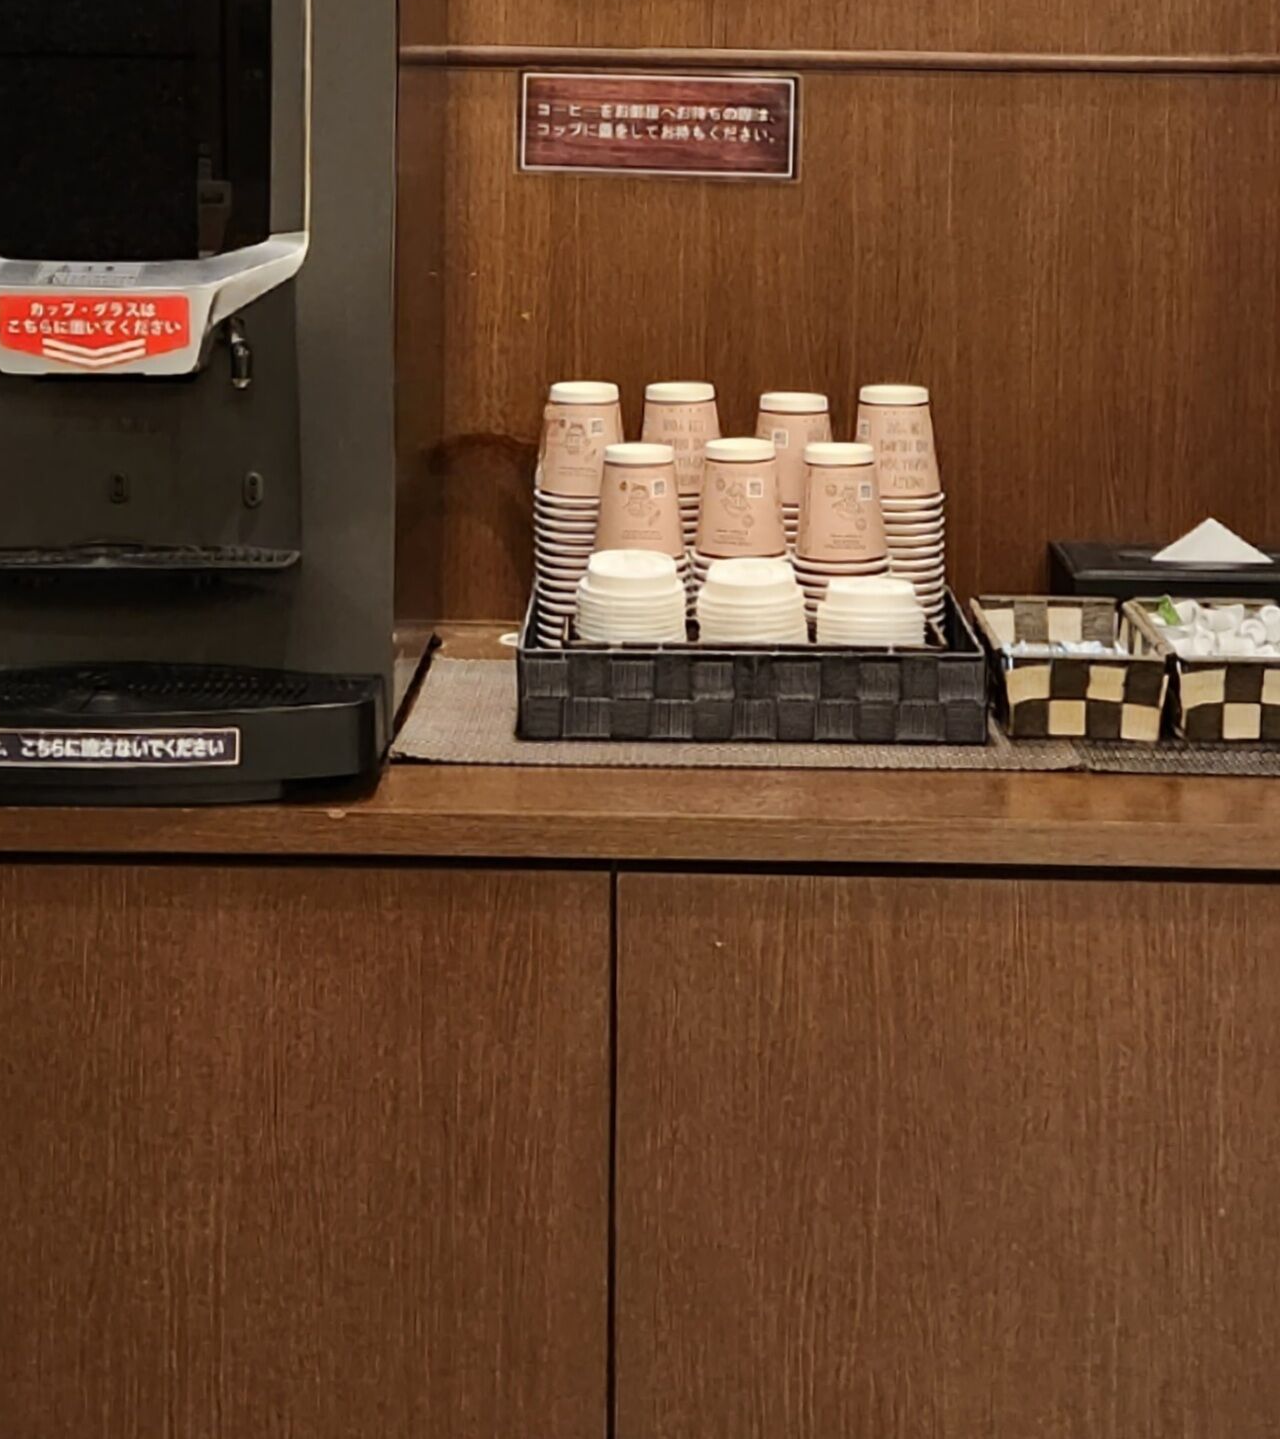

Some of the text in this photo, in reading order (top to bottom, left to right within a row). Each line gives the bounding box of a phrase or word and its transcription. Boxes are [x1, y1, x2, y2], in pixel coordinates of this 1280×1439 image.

[29, 301, 157, 319] カップ・グラスは
[6, 318, 183, 337] こちらに置いてください
